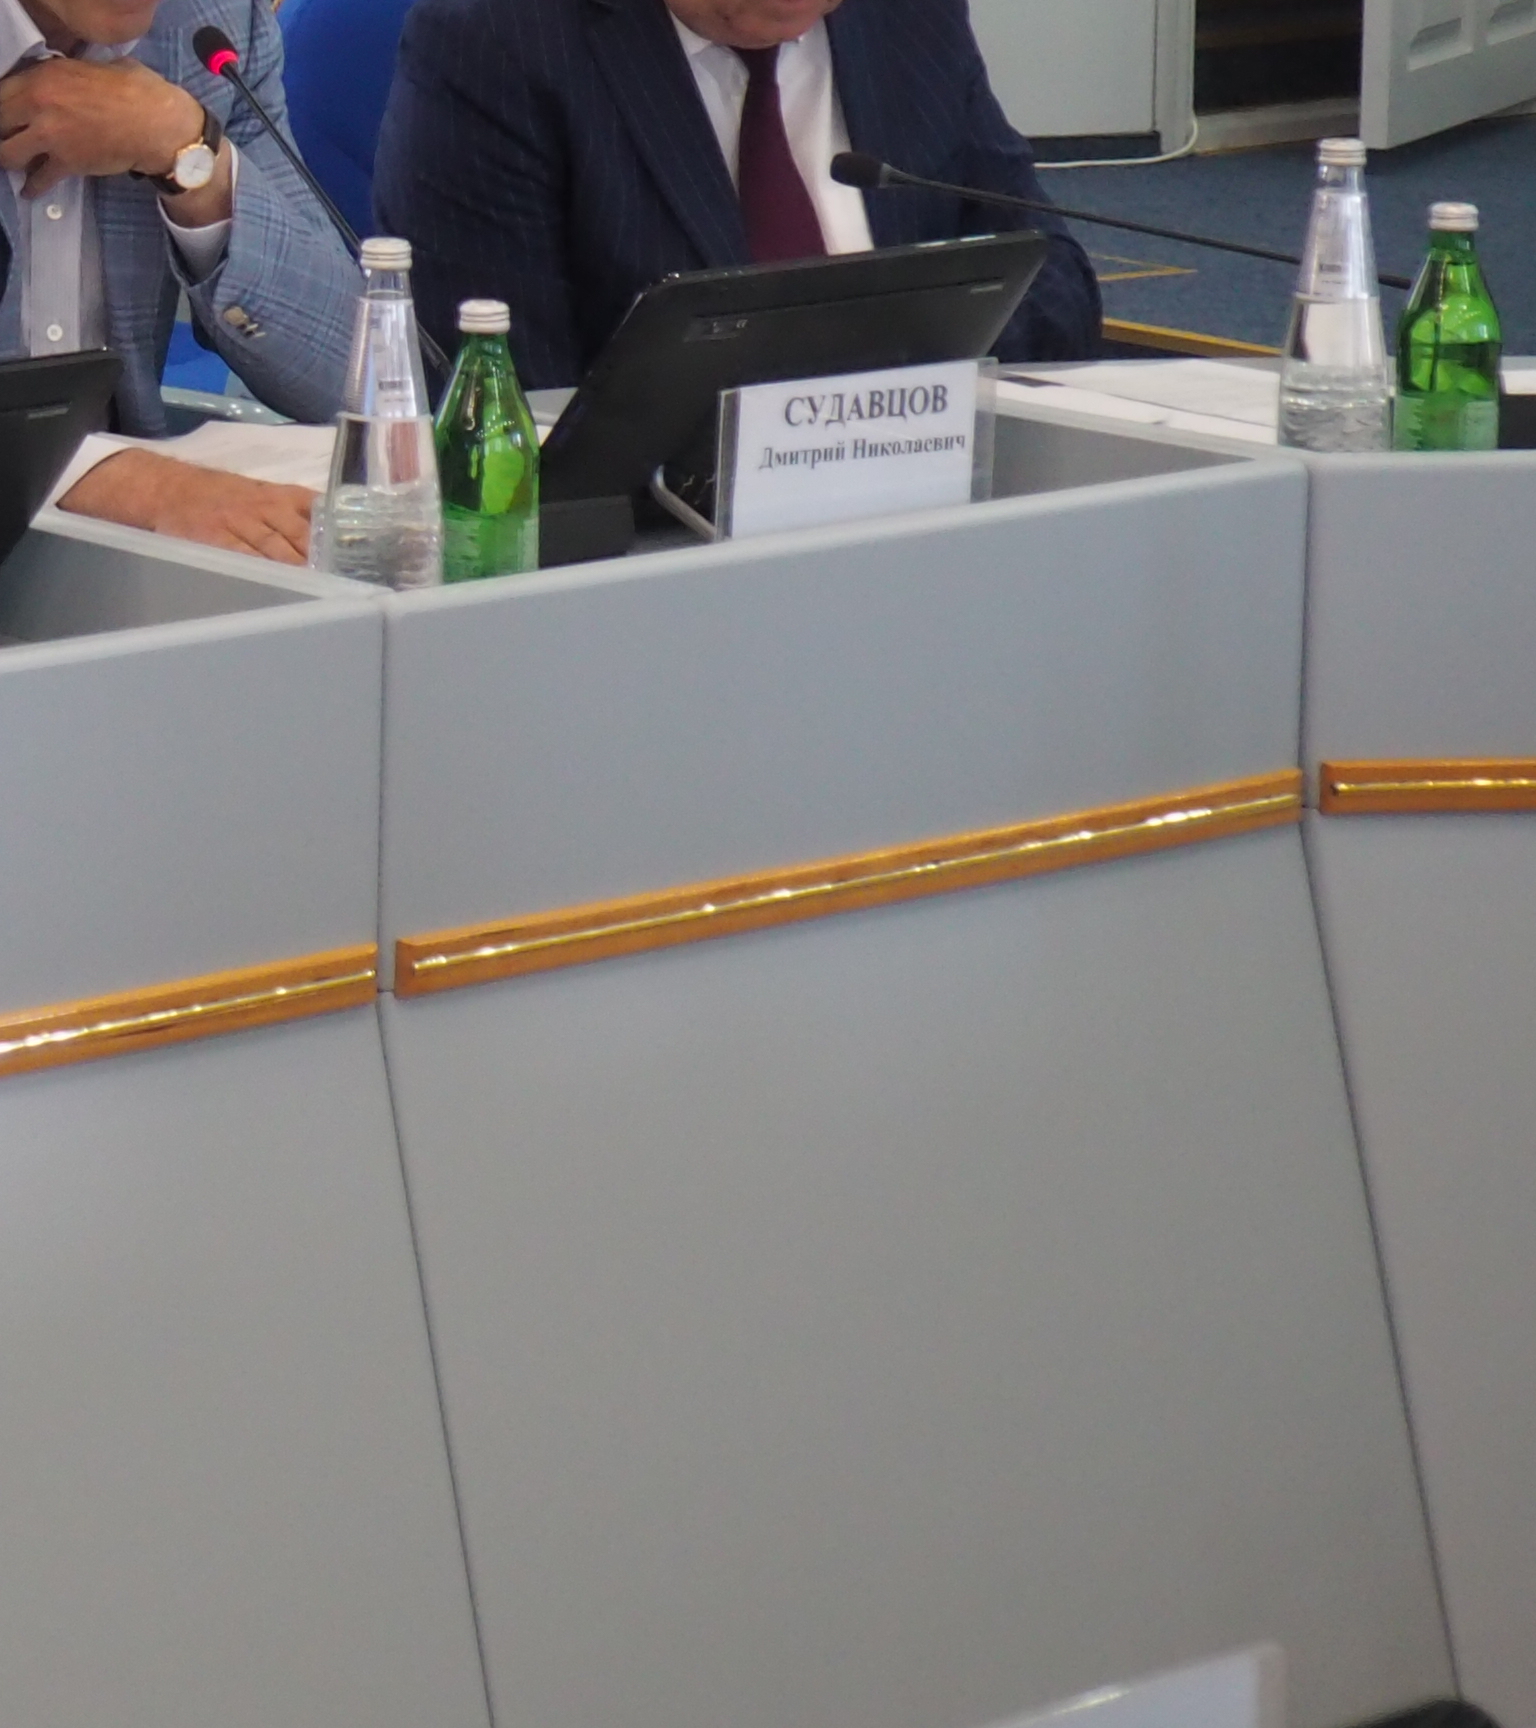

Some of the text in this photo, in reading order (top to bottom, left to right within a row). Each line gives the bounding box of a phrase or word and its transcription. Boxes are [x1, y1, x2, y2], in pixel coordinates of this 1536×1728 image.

[783, 384, 949, 428] СУДАВЦОВ
[758, 434, 966, 470] Дмитрий Николаевич
